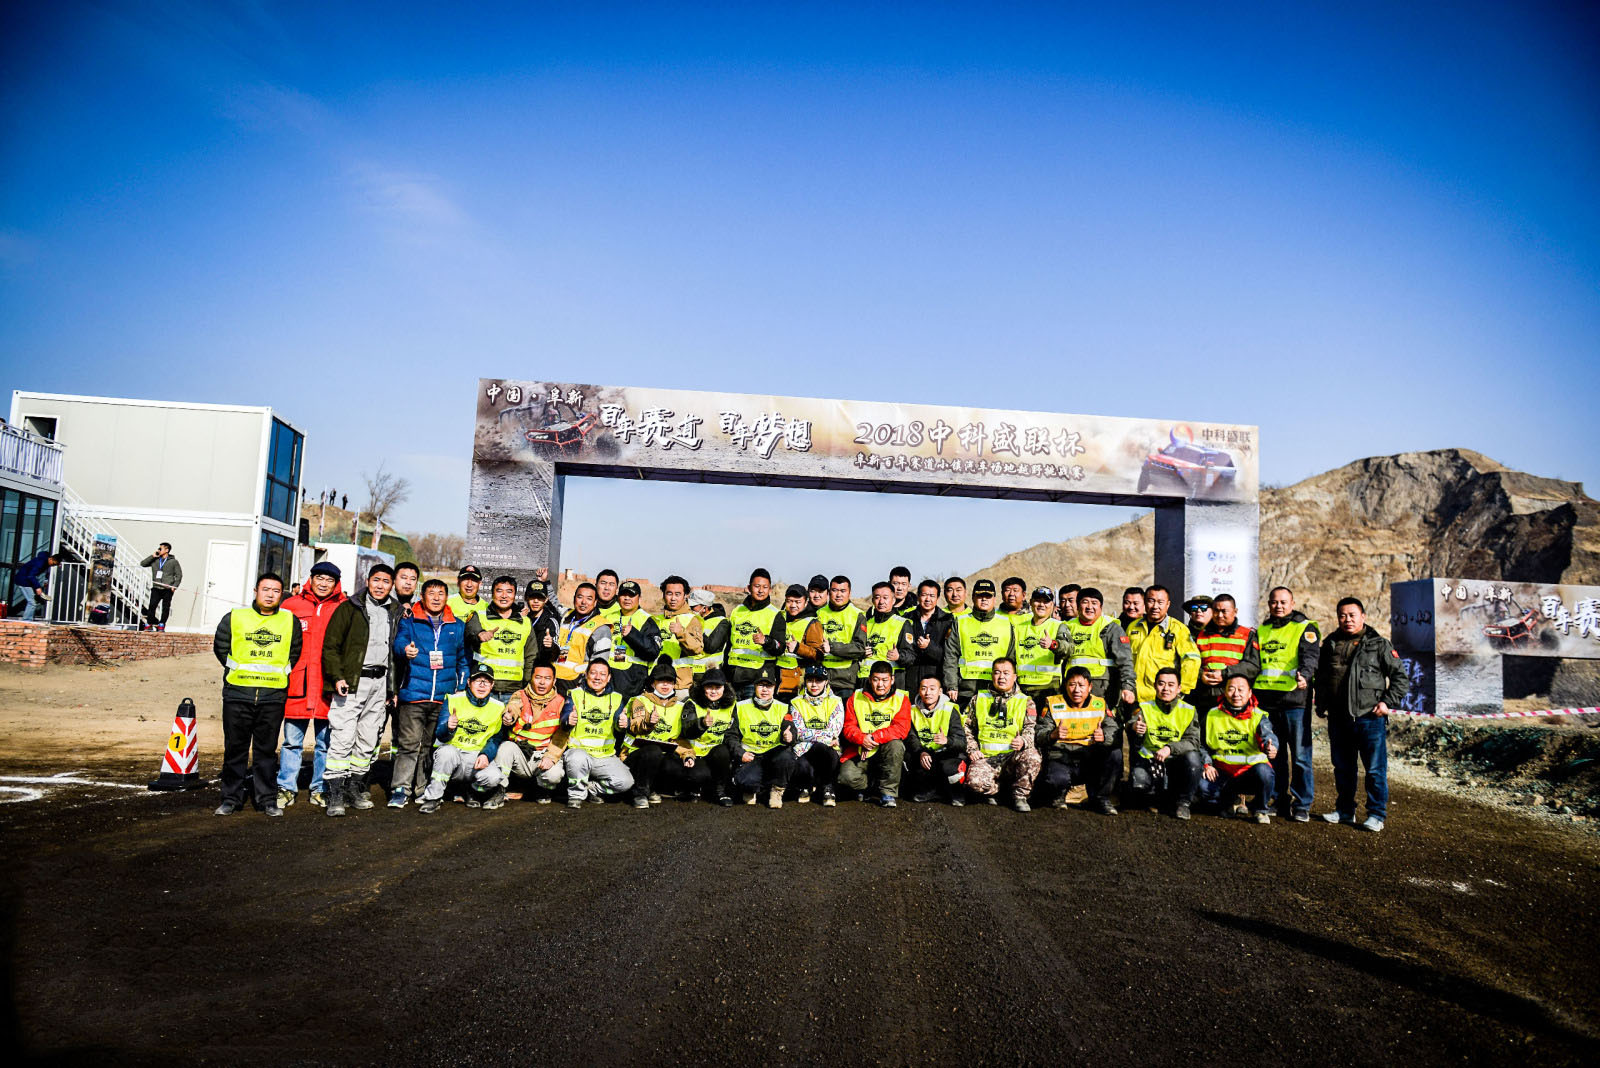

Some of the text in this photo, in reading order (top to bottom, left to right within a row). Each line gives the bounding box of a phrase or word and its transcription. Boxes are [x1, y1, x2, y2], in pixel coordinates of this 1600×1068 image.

[600, 403, 813, 459] 百年赛道 百年梦想
[854, 419, 1086, 458] 2018中科盛联杯
[1202, 427, 1251, 442] 中科盛联
[250, 650, 273, 658] 裁判员
